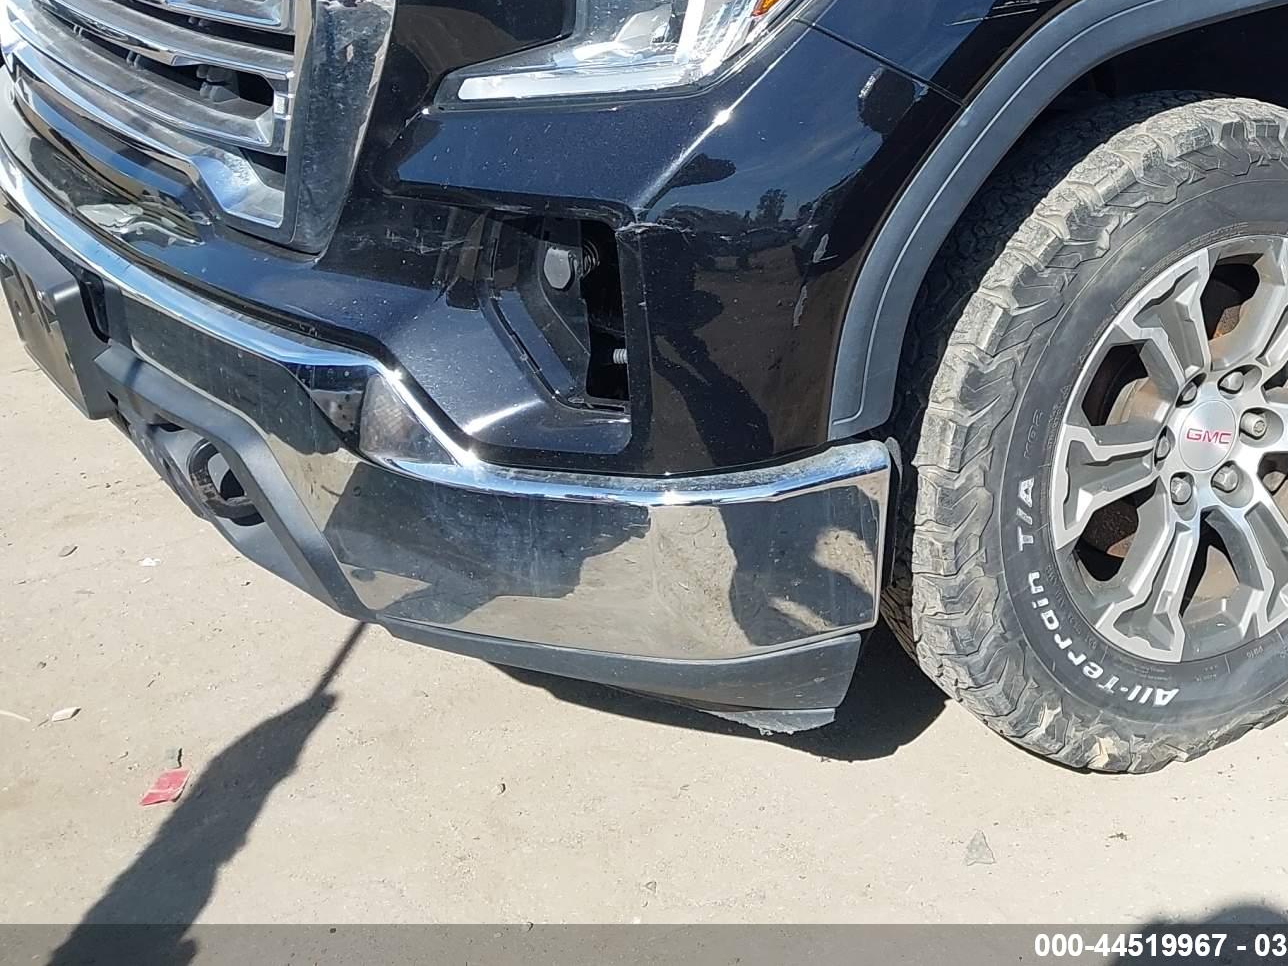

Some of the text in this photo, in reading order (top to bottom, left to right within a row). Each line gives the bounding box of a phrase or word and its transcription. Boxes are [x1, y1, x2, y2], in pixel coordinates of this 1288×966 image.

[1186, 428, 1232, 445] GMC
[1015, 476, 1035, 552] T/A
[1028, 570, 1180, 706] All-Terrain
